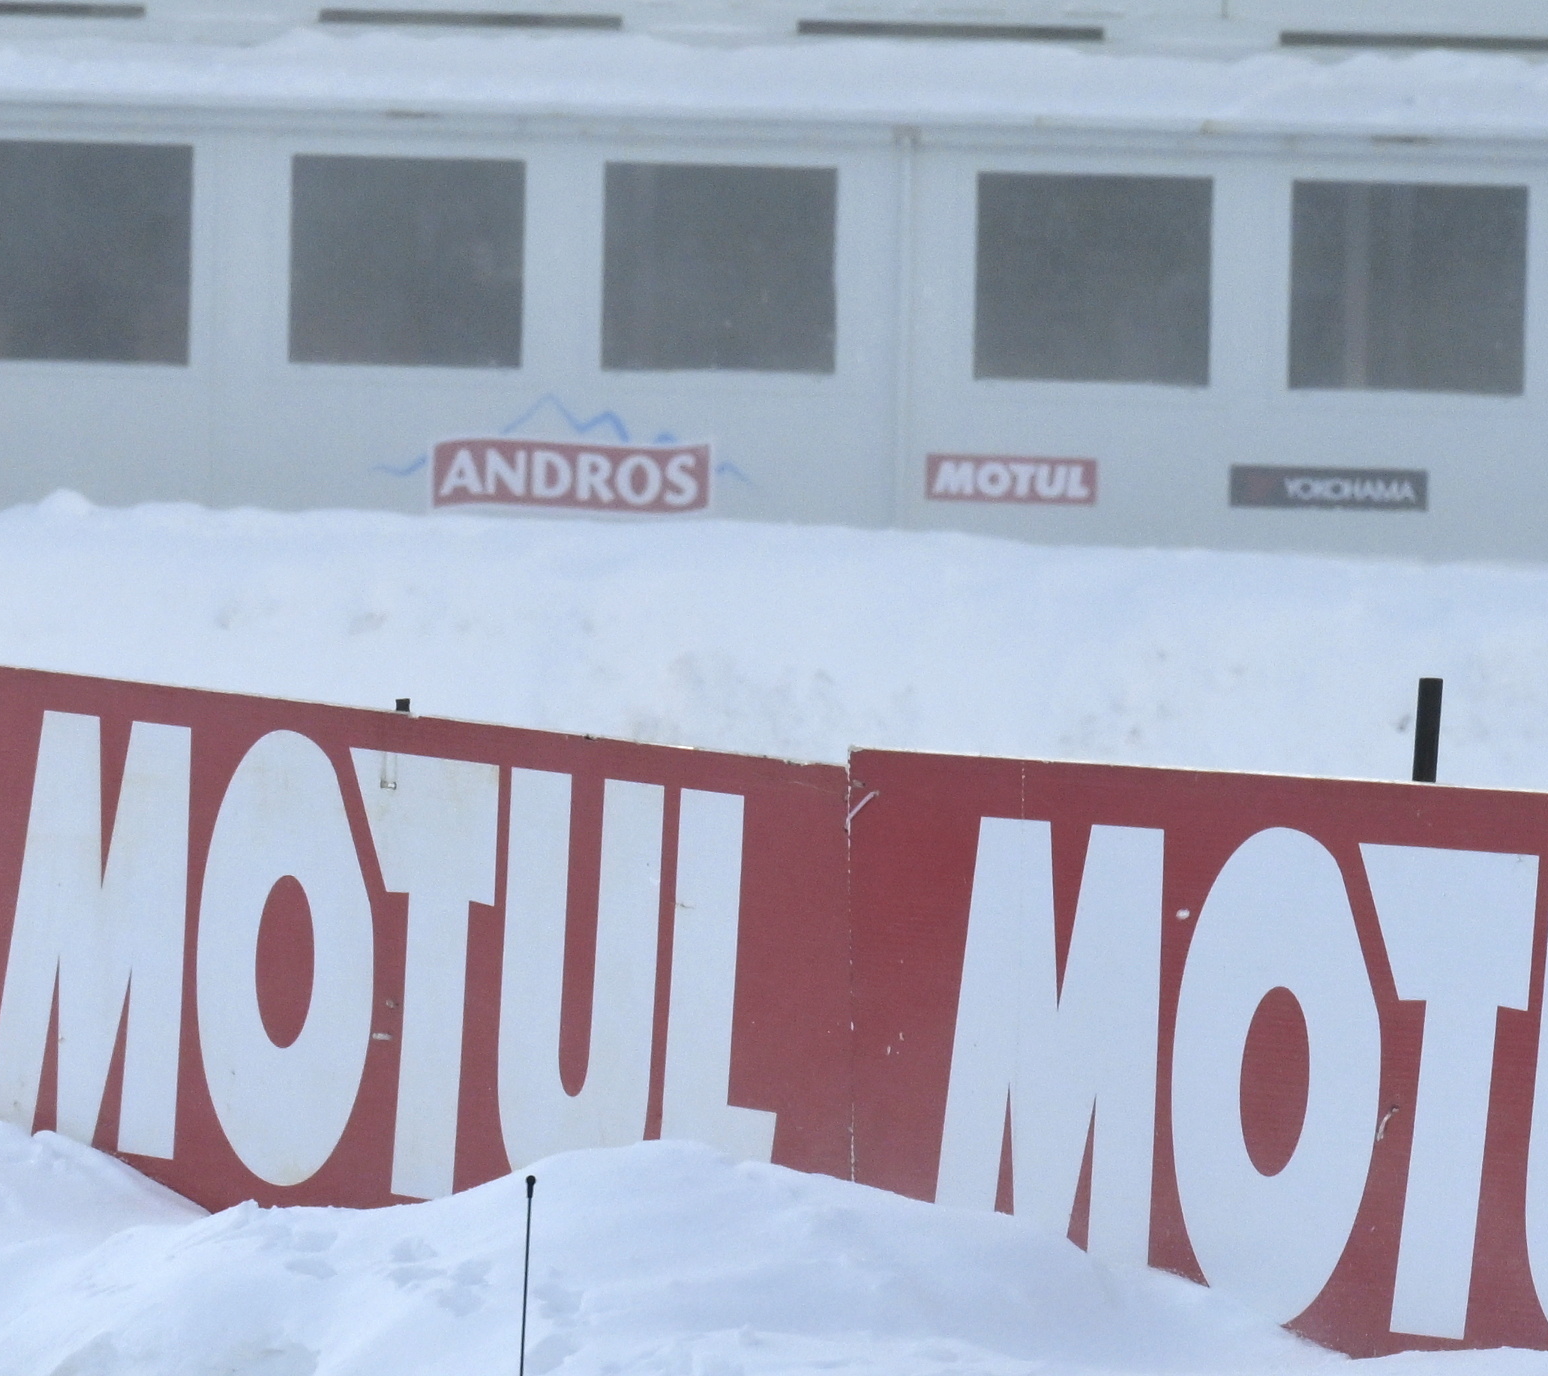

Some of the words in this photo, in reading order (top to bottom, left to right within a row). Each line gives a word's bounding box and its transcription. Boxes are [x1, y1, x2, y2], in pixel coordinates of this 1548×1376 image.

[439, 447, 700, 505] ANDROS
[932, 461, 1090, 499] MOTUL
[1284, 475, 1415, 502] YOKOHAMA
